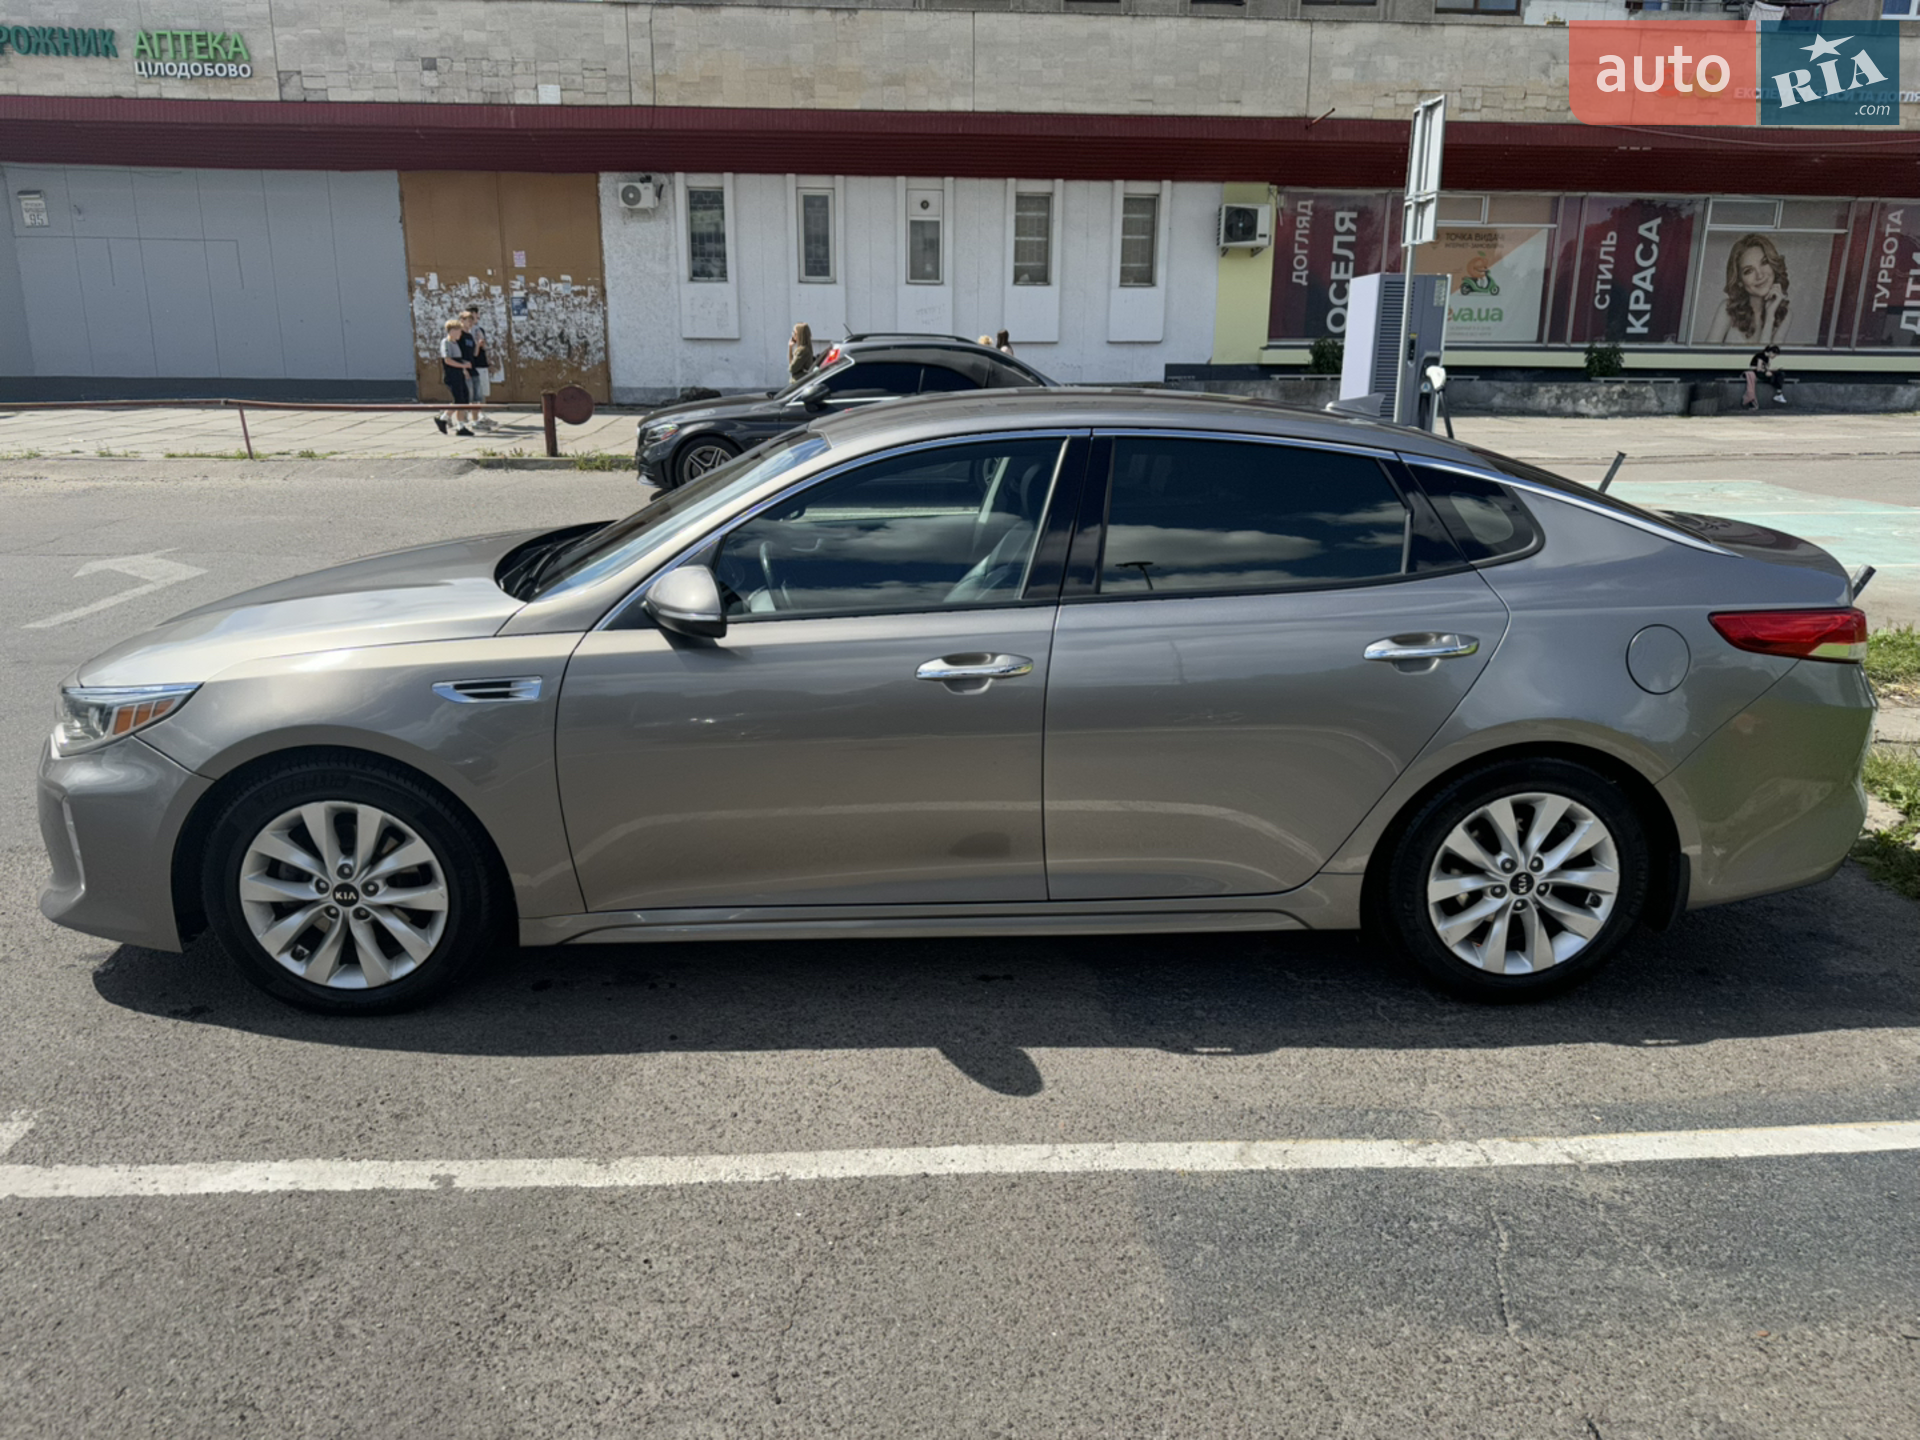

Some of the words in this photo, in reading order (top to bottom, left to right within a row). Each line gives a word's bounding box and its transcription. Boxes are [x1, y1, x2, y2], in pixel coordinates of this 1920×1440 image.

[134, 30, 251, 61] АПТЕКА
[134, 61, 253, 78] ЦІЛОДОБОВО
[1292, 199, 1314, 286] ДОГЛЯД
[1326, 211, 1358, 334] ОСЕЛЯ
[1594, 231, 1617, 310] СТИЛЬ
[1626, 216, 1662, 334] КРАСА
[1872, 209, 1904, 313] ТУРБОТА
[336, 891, 357, 900] KIA
[1518, 874, 1527, 893] KIA
